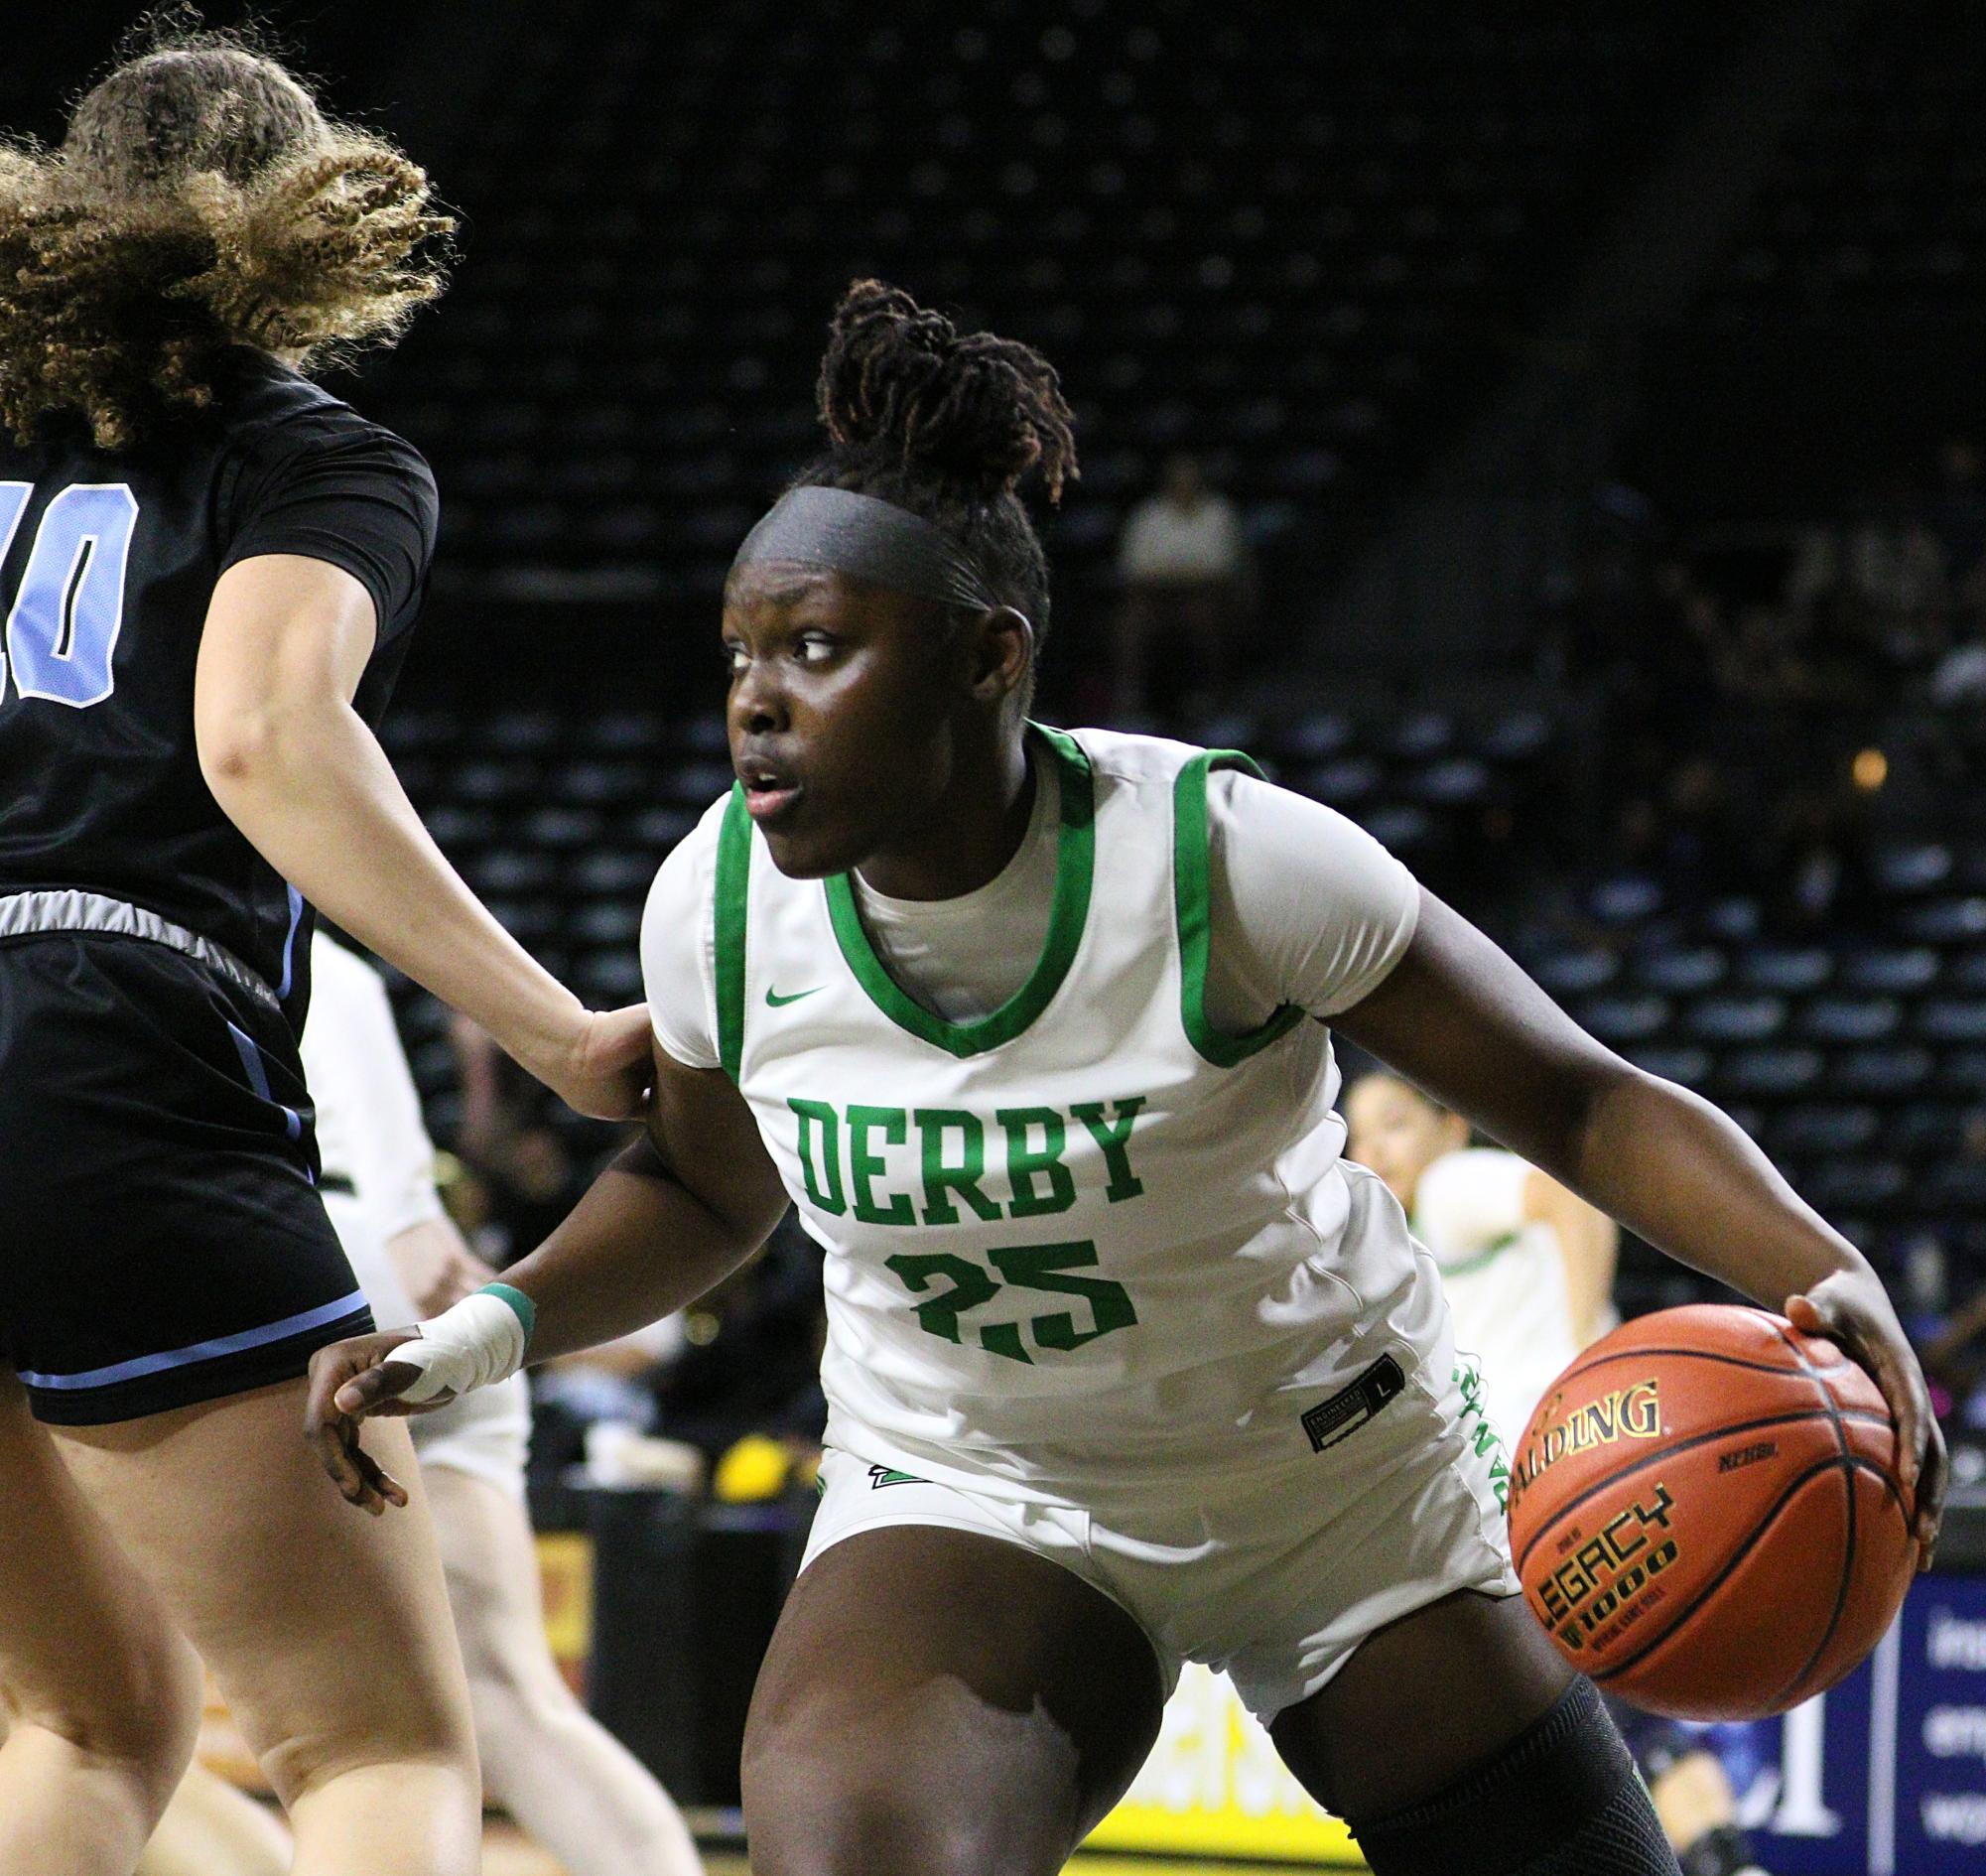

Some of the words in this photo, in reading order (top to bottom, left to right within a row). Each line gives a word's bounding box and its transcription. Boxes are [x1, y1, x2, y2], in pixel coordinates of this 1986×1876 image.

[786, 1096, 1146, 1226] DERBY
[884, 1239, 1138, 1365] 25
[1377, 1383, 1390, 1398] L
